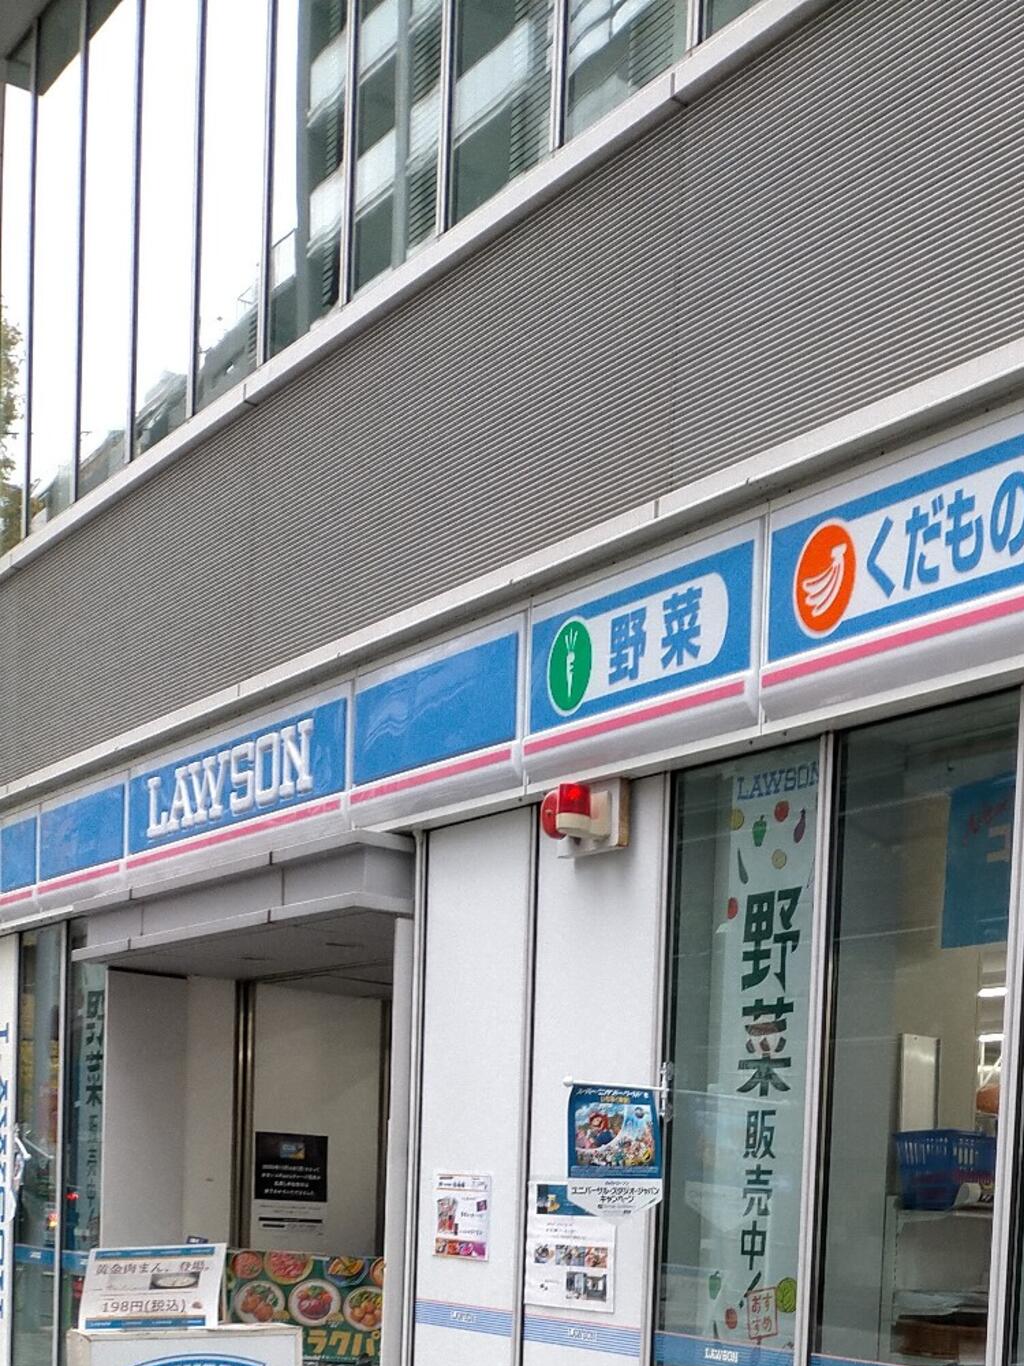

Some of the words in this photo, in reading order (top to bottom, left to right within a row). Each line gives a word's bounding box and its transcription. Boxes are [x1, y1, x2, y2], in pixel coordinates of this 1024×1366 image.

[607, 585, 702, 686] 野菜
[147, 718, 314, 839] LAWSON
[736, 764, 819, 801] LAWSON
[704, 1347, 740, 1364] LAWSON
